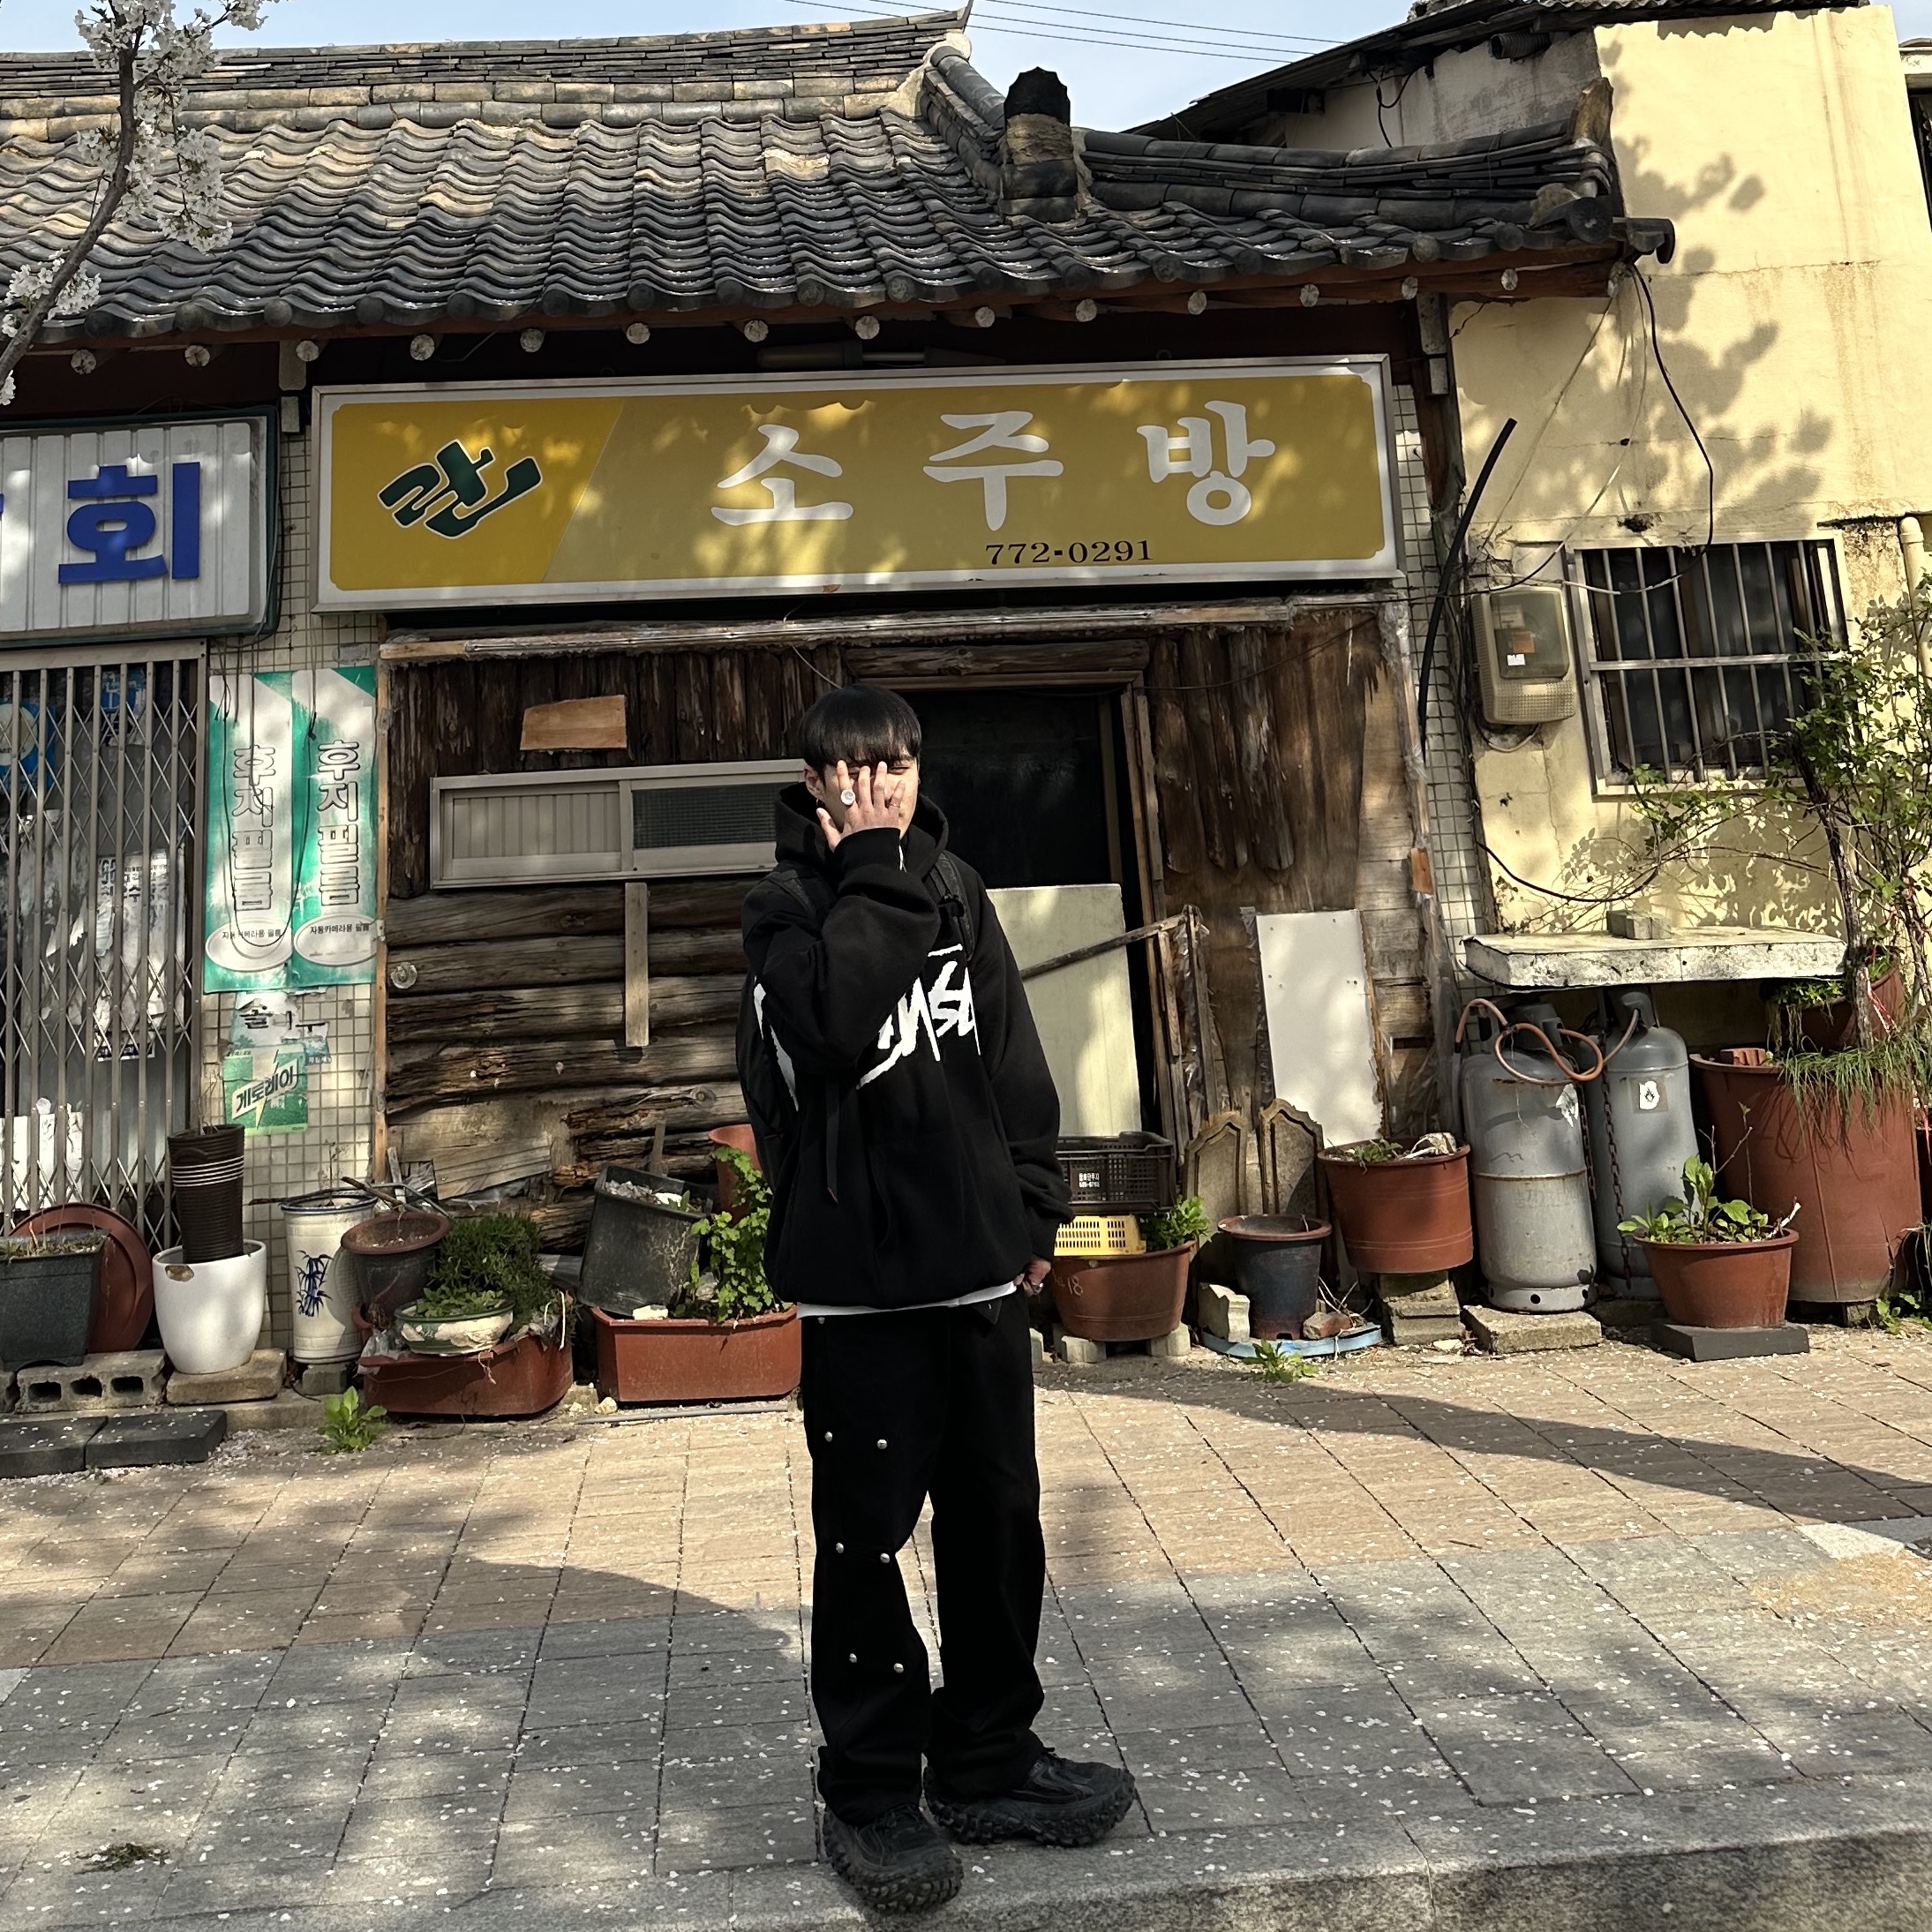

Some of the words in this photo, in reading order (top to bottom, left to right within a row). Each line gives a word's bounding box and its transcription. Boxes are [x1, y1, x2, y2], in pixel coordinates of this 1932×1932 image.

[0, 462, 200, 583] 회
[986, 540, 1152, 565] 772-0291
[231, 744, 275, 912] 후지필름
[317, 740, 360, 906] 후지필름
[236, 1065, 294, 1113] 게토레이
